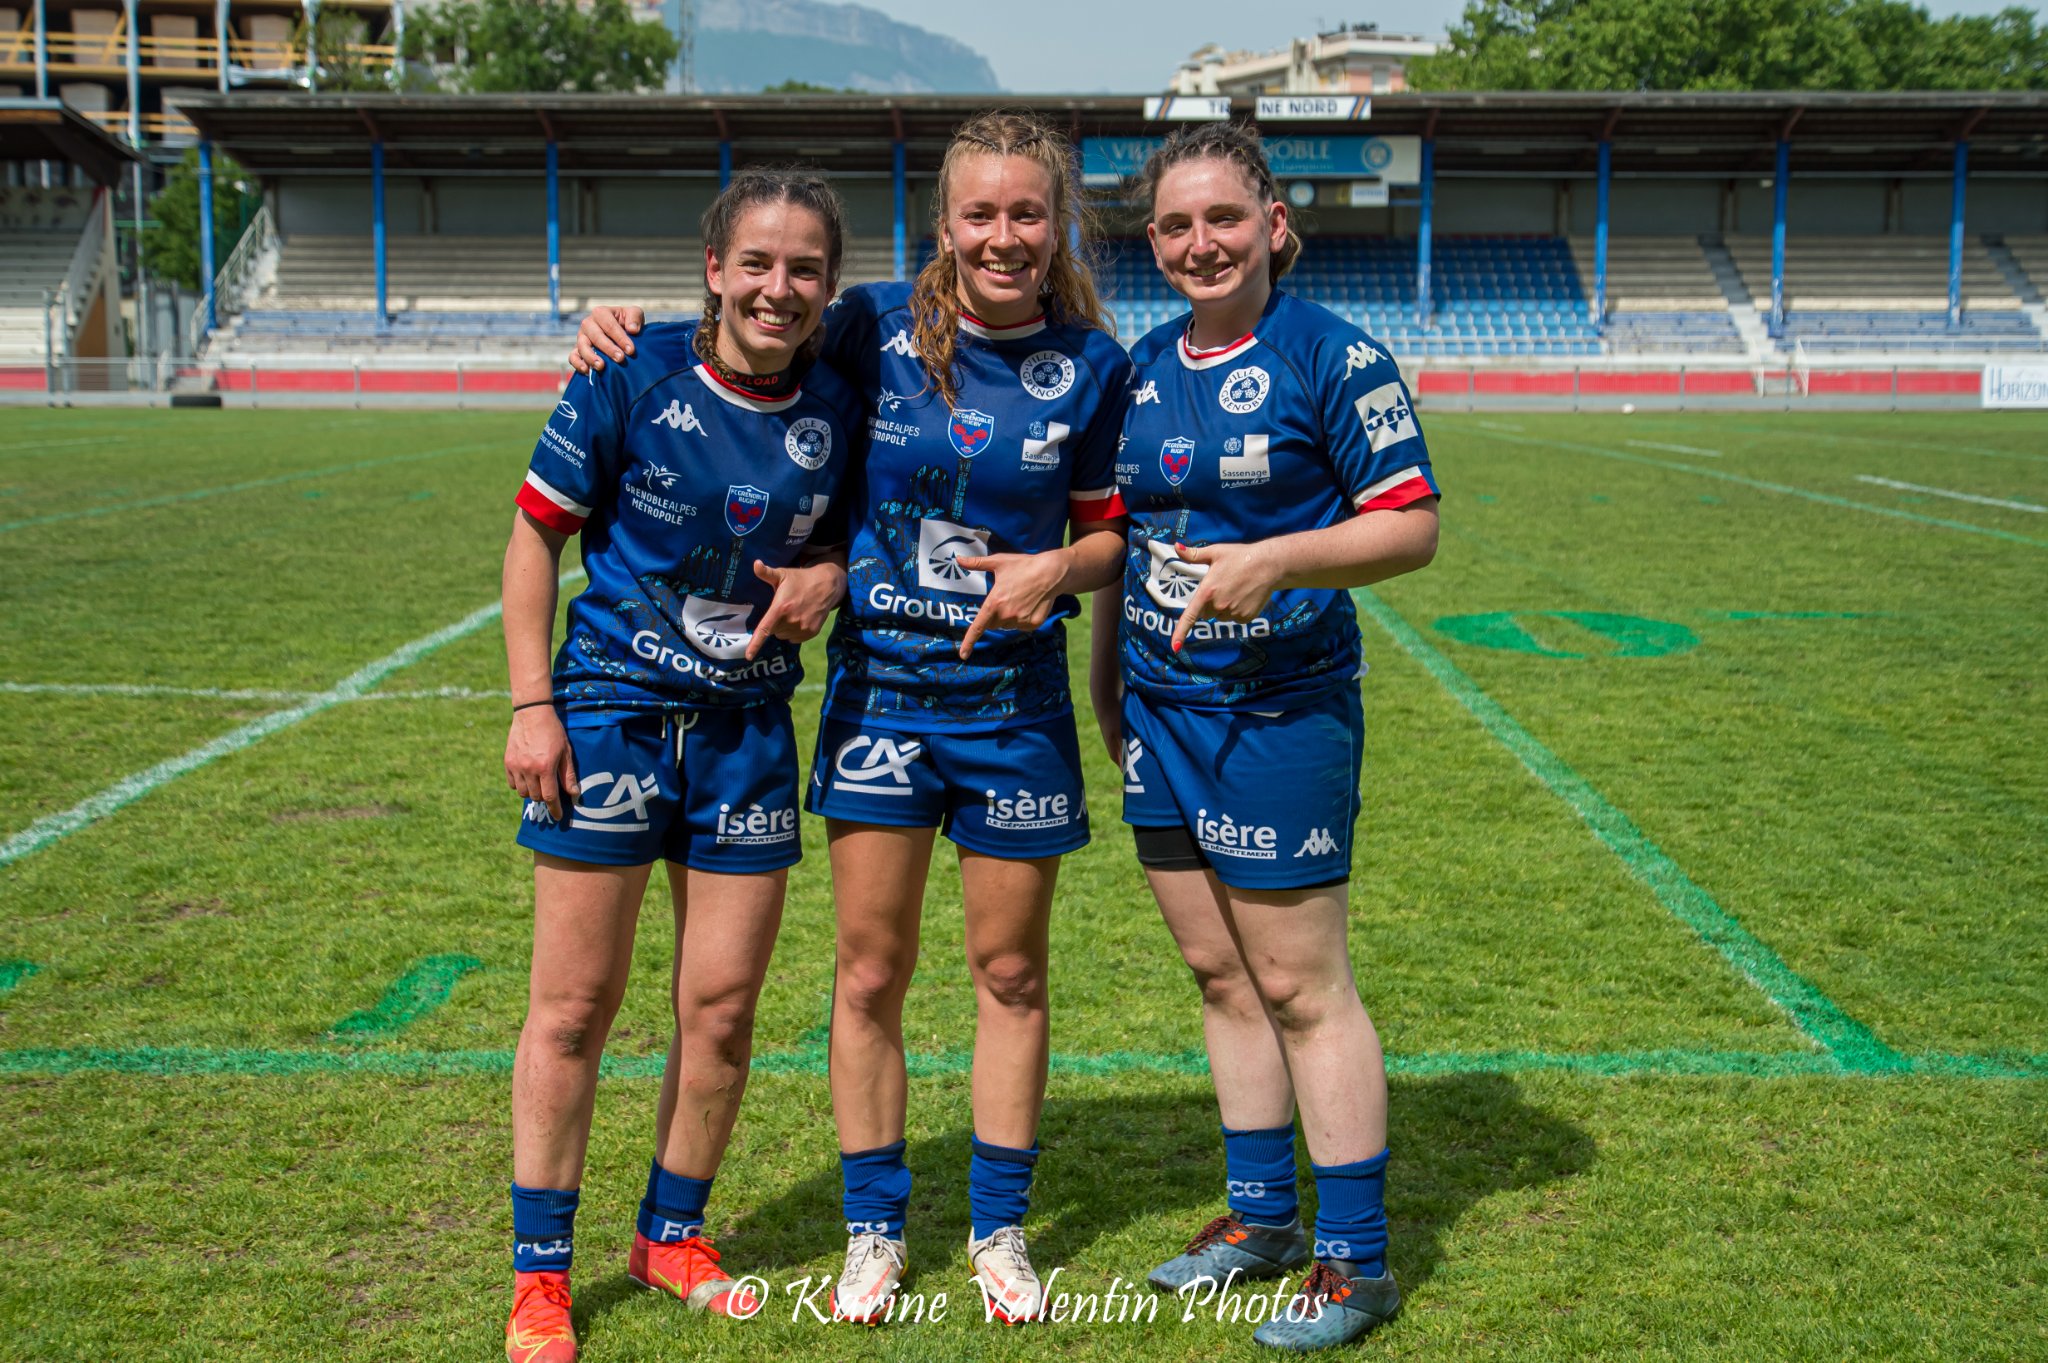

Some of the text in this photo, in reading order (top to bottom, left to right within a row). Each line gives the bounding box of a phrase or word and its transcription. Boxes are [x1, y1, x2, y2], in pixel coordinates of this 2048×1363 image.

[1289, 100, 1338, 114] NORD
[1024, 352, 1072, 371] VILLE DE
[1023, 371, 1072, 397] GRENOBLE
[789, 420, 817, 437] VILLE
[1222, 469, 1268, 477] Sassenage
[631, 497, 684, 526] MÉTROPOLE
[869, 583, 979, 627] Groupa
[1124, 594, 1271, 640] Grouama
[986, 788, 1069, 820] isère
[717, 802, 796, 836] isère
[988, 817, 1068, 829] LE DÉPARTEMENT
[1197, 808, 1278, 849] isère
